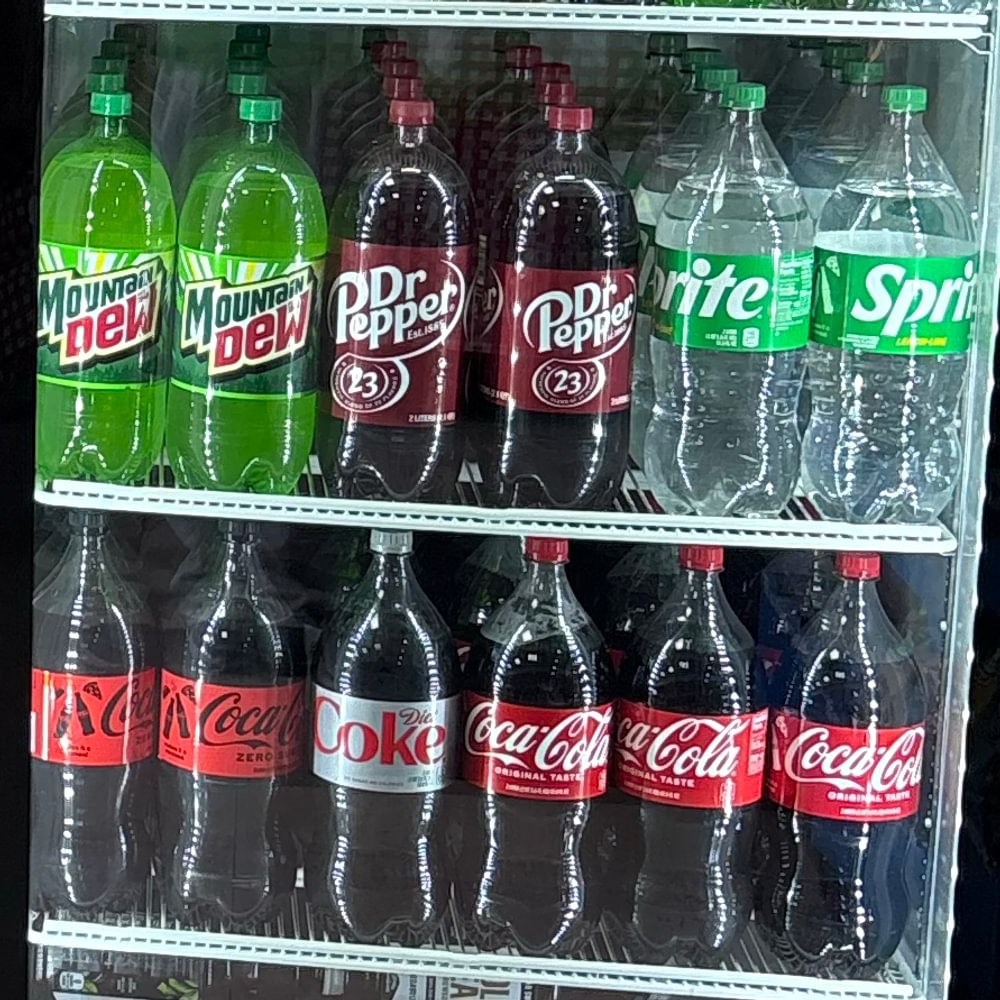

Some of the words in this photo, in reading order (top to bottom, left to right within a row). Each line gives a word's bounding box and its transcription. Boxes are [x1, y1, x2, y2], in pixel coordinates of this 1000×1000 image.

[335, 271, 458, 350] Pepper
[370, 264, 428, 310] Dr
[574, 281, 618, 320] Dr
[638, 247, 769, 320] prite
[850, 260, 978, 338] Spri
[213, 288, 310, 369] DEW
[534, 290, 634, 355] Pepper
[348, 366, 379, 398] 23
[553, 369, 581, 395] 23
[236, 752, 273, 763] ZERO
[313, 694, 447, 766] Coke
[464, 701, 613, 773] Coca-Cola
[617, 717, 752, 778] ca-Cola
[785, 726, 924, 792] Coca-Col
[494, 766, 547, 781] ORIGINAL
[549, 773, 584, 782] TASTE
[660, 775, 695, 788] TASTE
[827, 791, 883, 803] ORIGINAL
[885, 790, 911, 801] TASTE
